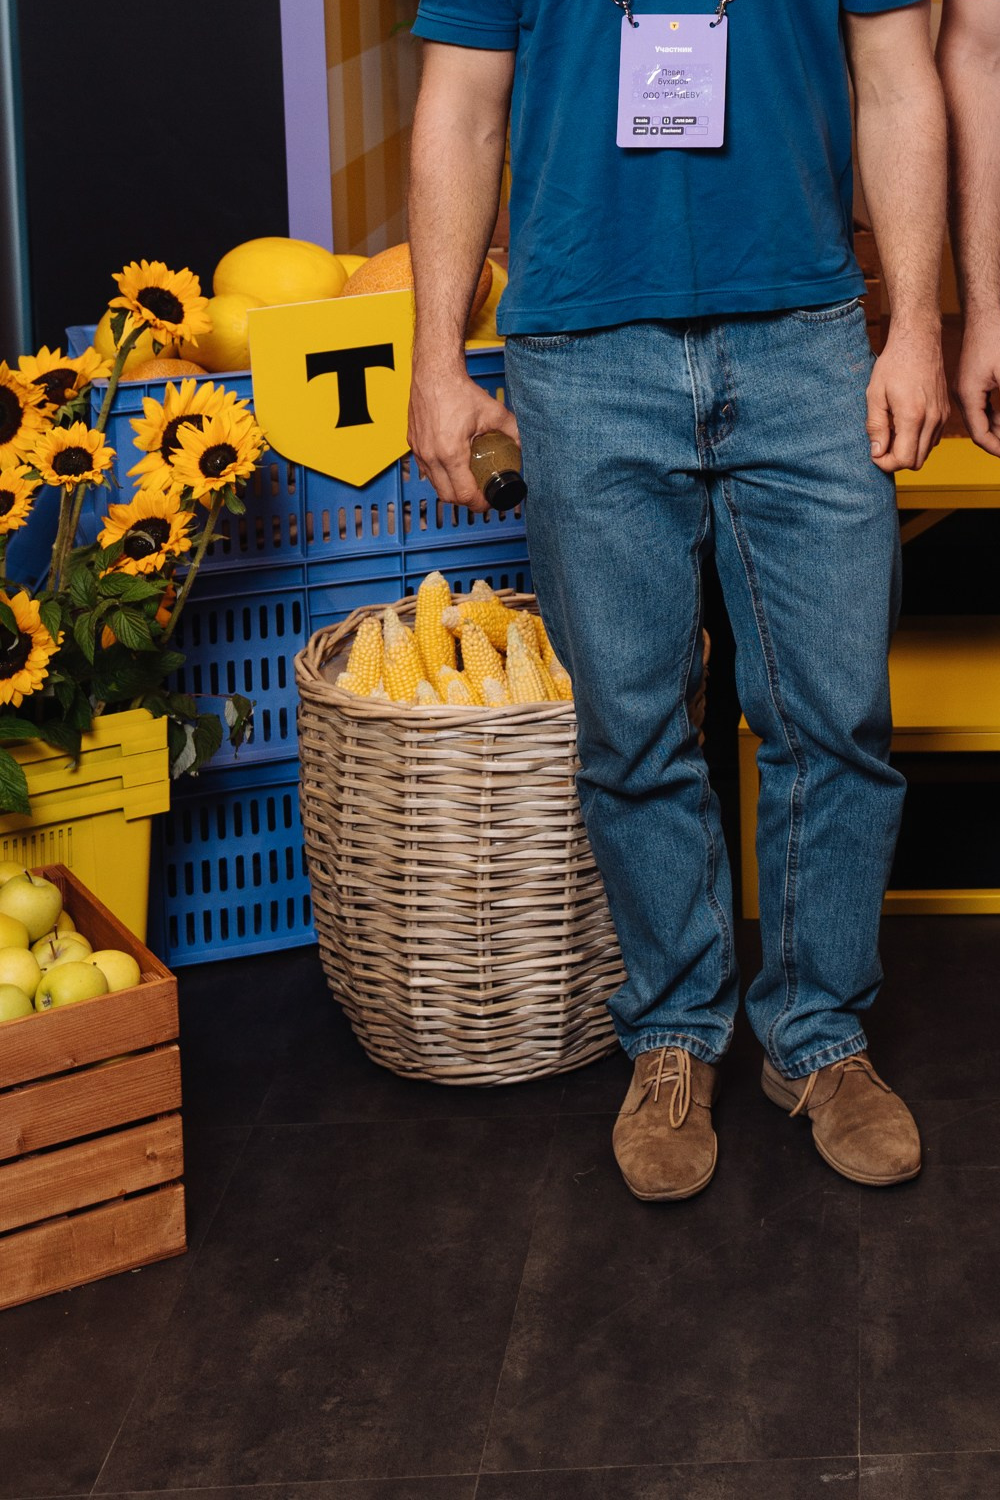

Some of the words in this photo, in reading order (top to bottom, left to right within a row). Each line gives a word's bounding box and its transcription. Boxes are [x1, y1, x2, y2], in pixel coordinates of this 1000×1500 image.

[654, 45, 692, 53] Участник
[661, 68, 685, 76] Павел
[305, 342, 396, 429] T
